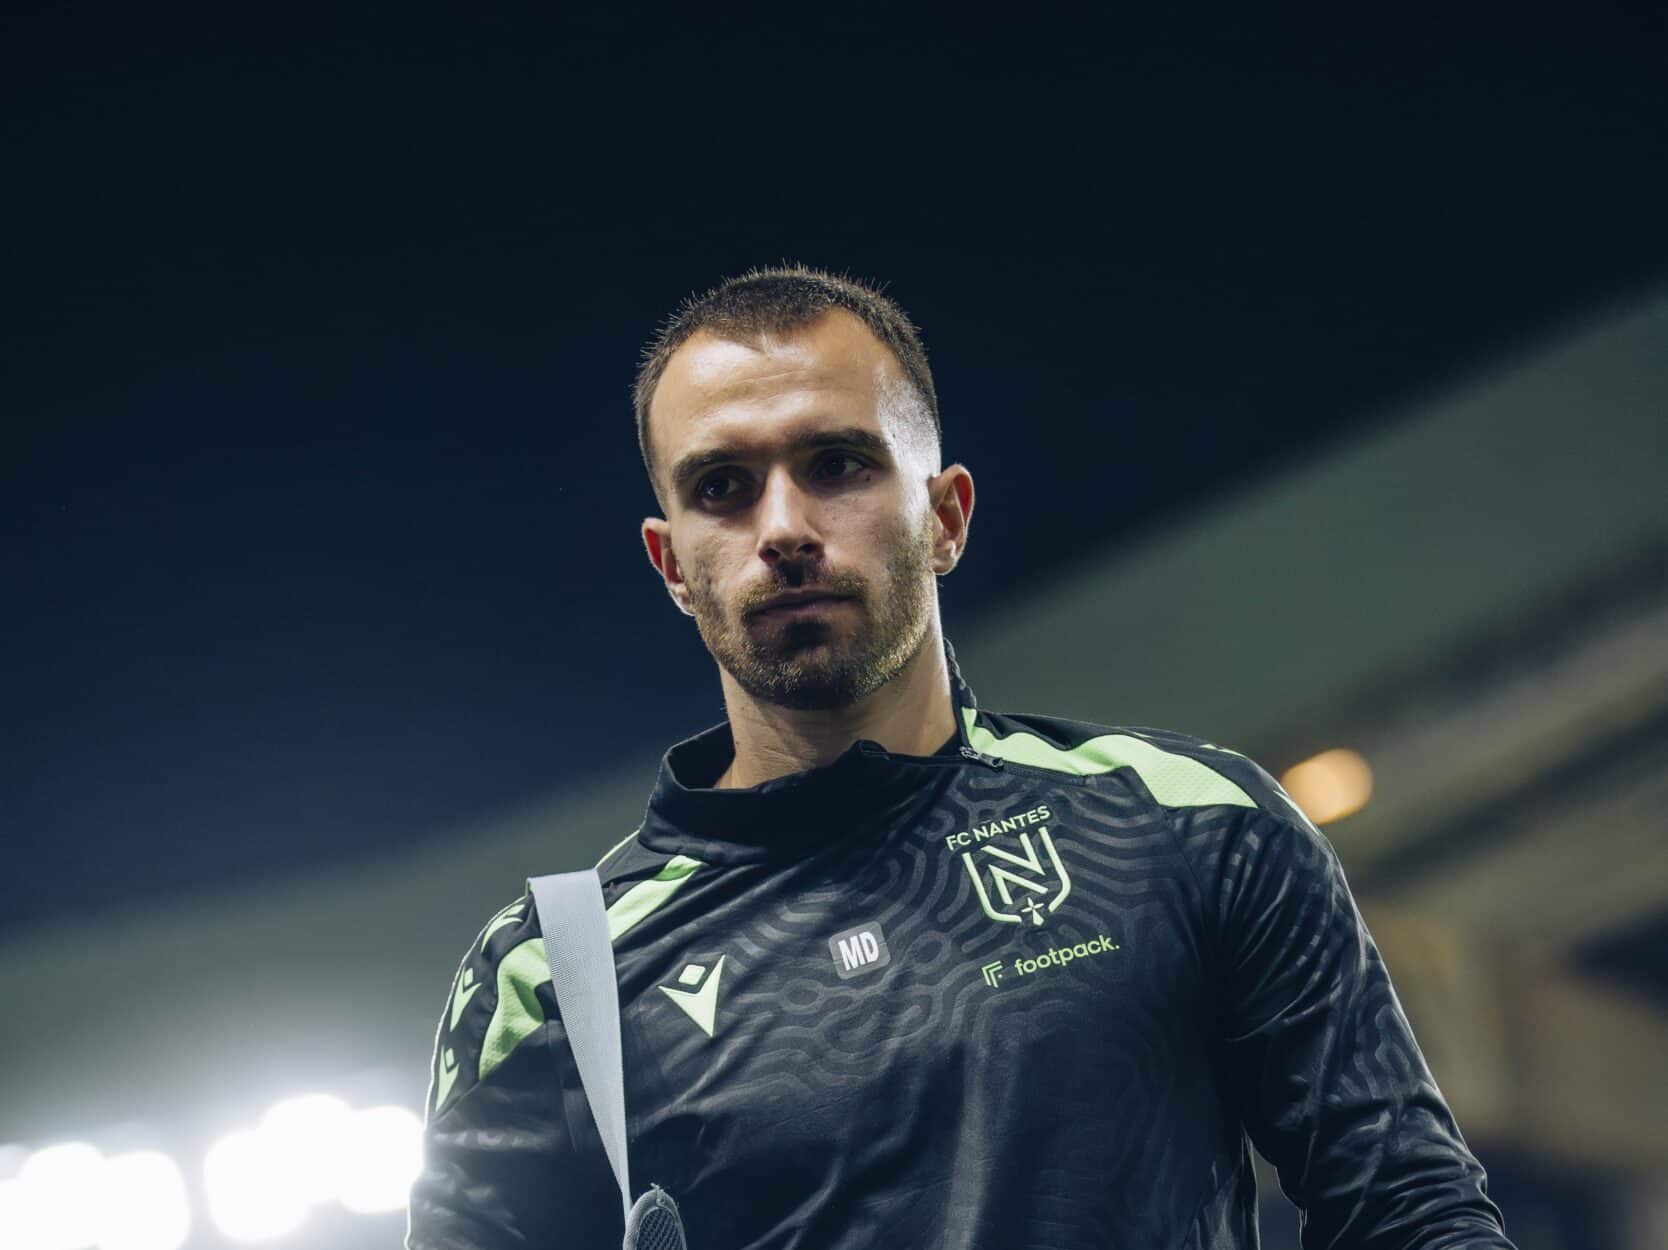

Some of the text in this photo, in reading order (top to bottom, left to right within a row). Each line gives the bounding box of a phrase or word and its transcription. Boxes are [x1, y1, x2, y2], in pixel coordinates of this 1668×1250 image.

[945, 805, 1051, 850] FC NANTES
[838, 931, 879, 971] MD
[1014, 935, 1120, 976] footpack.
